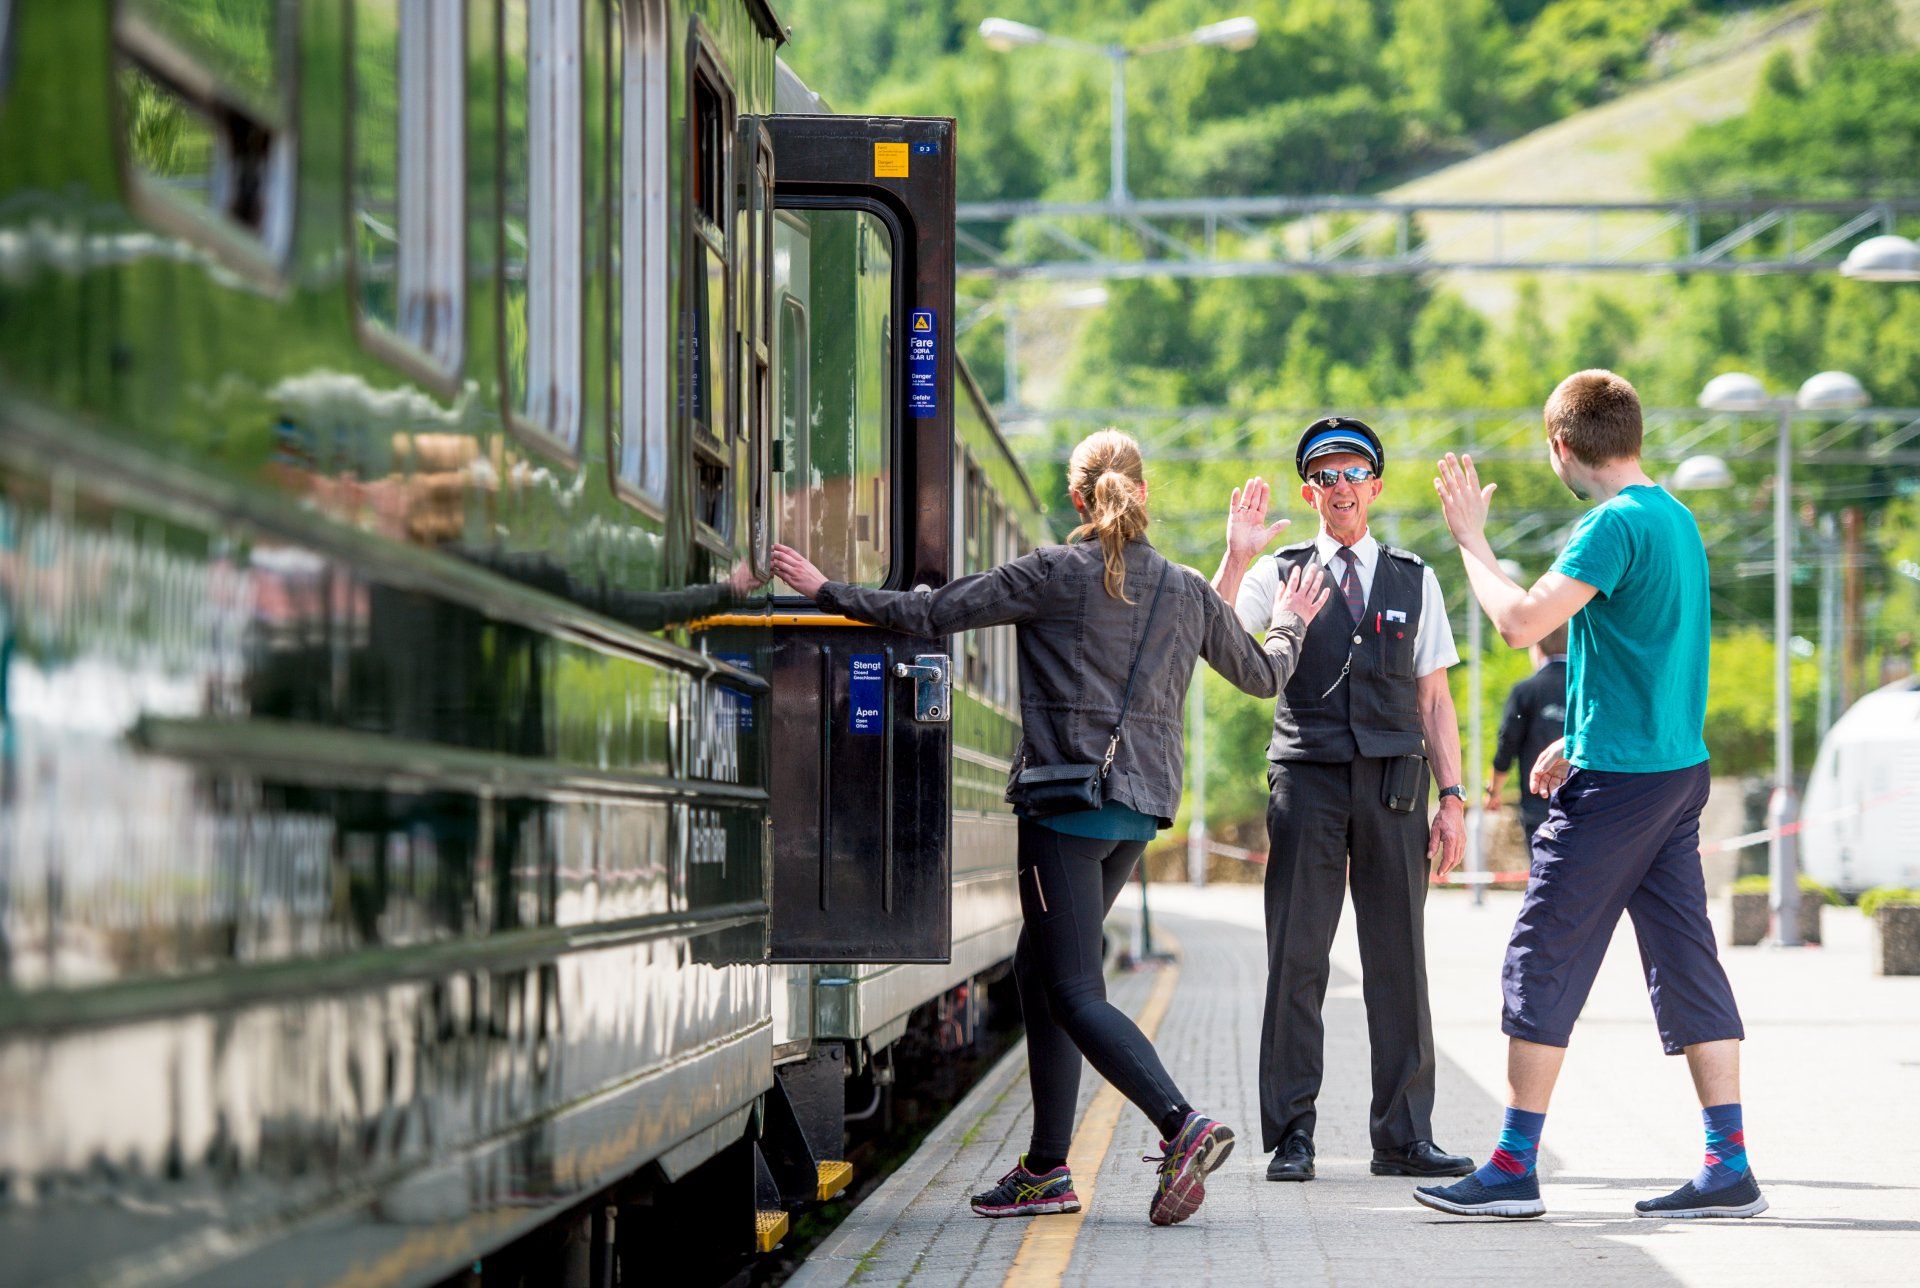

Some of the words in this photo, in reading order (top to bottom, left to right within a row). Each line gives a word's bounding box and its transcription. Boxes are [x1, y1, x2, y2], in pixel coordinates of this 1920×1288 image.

[910, 337, 933, 347] Fare
[853, 661, 881, 670] Stengt
[856, 707, 878, 717] Åpen
